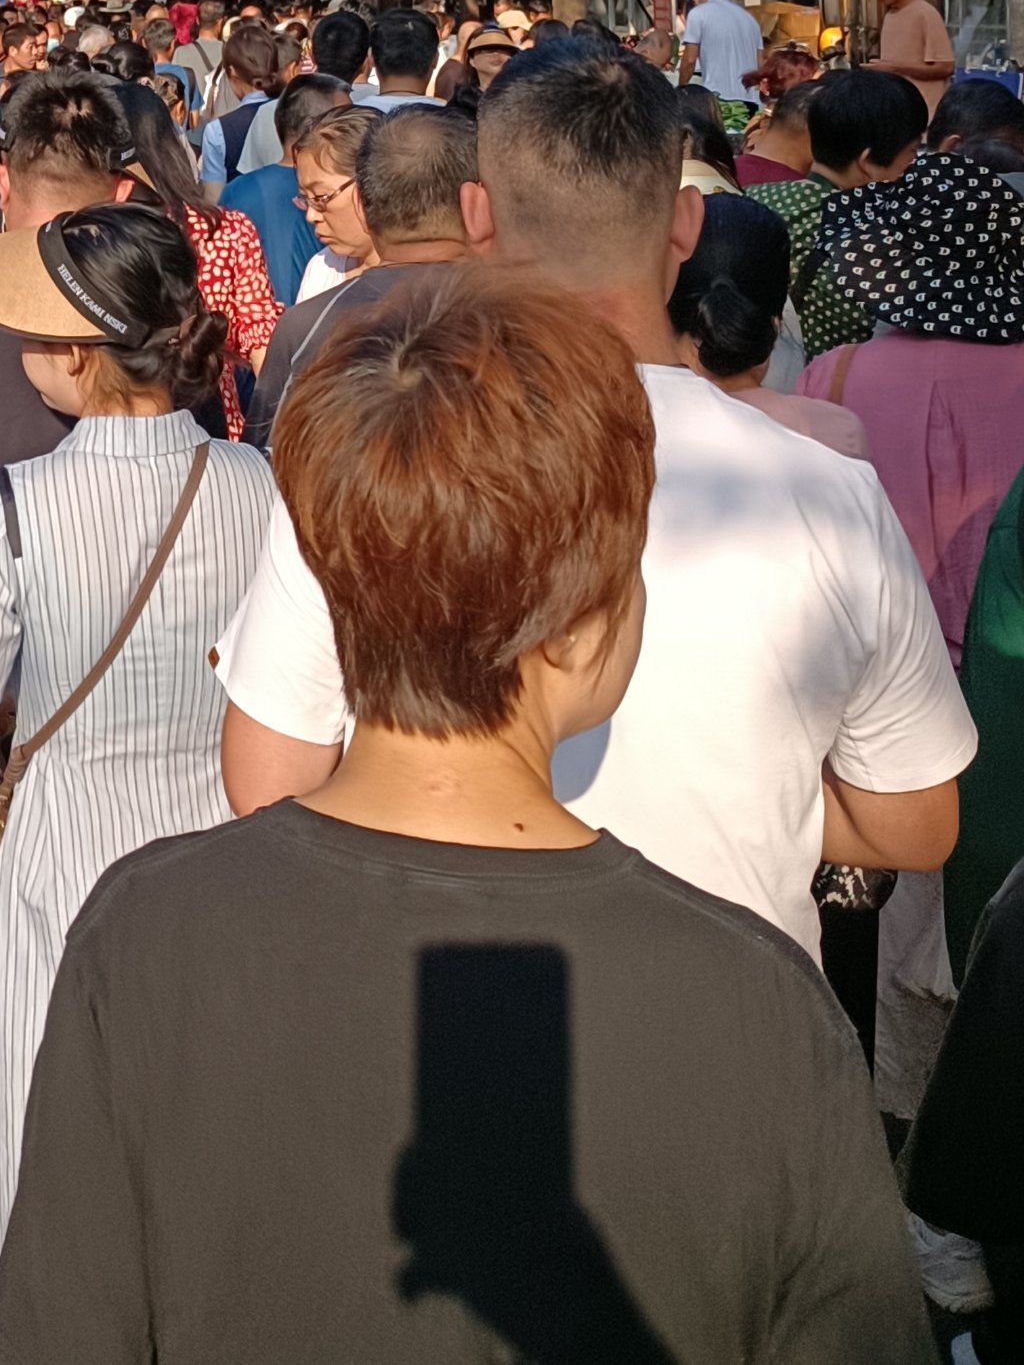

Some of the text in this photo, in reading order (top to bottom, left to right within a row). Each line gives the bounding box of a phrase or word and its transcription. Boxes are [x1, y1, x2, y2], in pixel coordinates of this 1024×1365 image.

[954, 168, 964, 176] D
[906, 173, 914, 182] D
[921, 177, 933, 186] D
[968, 178, 978, 186] D
[992, 178, 1002, 187] D
[937, 184, 948, 192] D
[954, 190, 964, 200] D
[979, 191, 991, 199] D
[1004, 191, 1013, 199] D
[905, 196, 916, 205] D
[966, 202, 977, 211] D
[987, 222, 997, 230] D
[1010, 217, 1021, 226] D
[944, 224, 952, 232] D
[965, 223, 974, 232] D
[895, 231, 903, 241] D
[955, 236, 965, 245] D
[978, 233, 989, 242] D
[913, 241, 924, 250] D
[939, 247, 950, 255] D
[966, 249, 976, 257] D
[949, 261, 960, 270] D
[57, 263, 84, 296] HELEN
